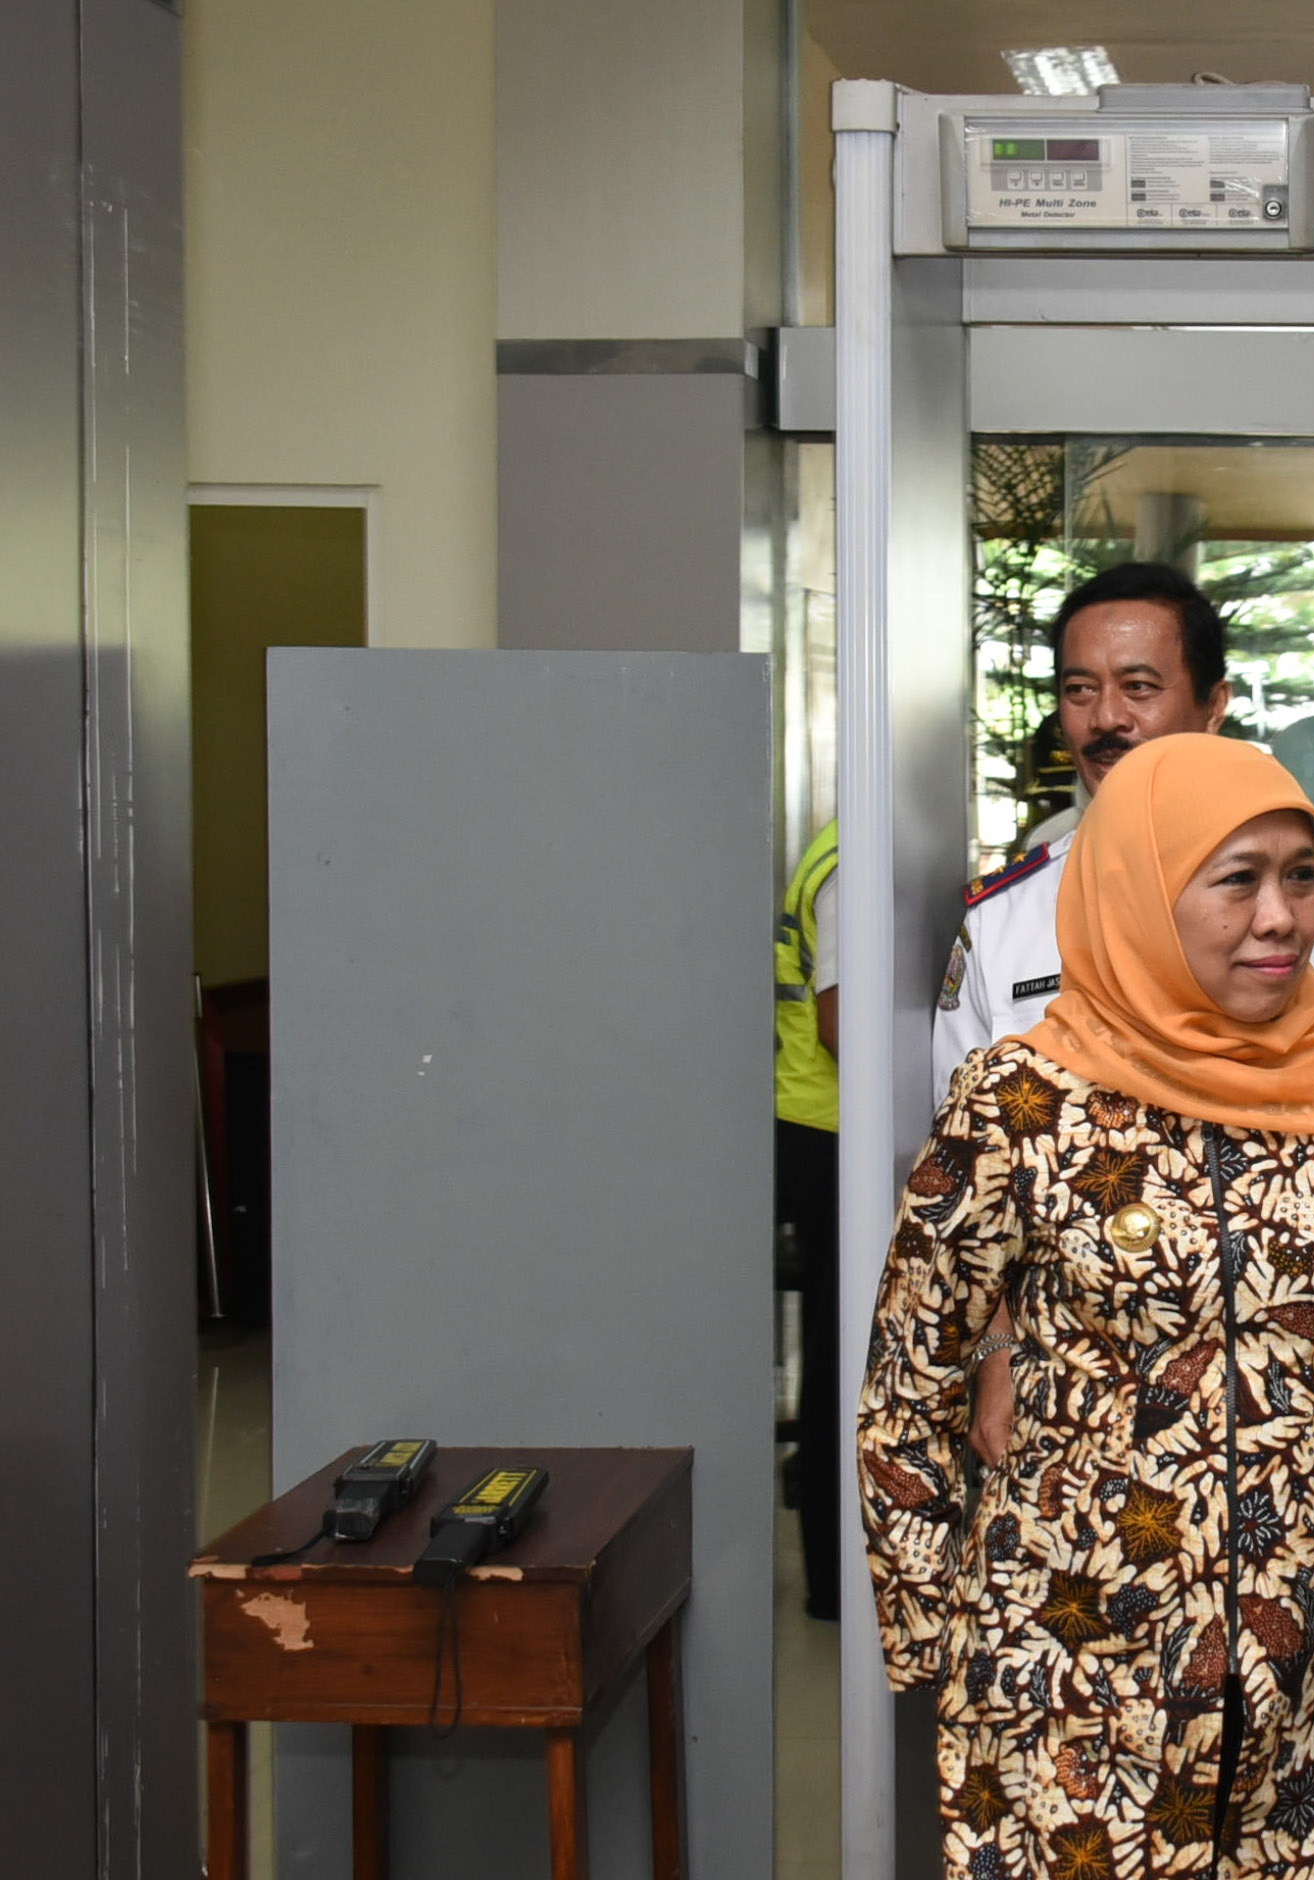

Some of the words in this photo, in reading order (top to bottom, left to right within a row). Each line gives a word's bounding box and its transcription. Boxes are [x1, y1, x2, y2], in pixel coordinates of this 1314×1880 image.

[1035, 198, 1064, 208] Multi
[1068, 199, 1097, 208] Zone
[1015, 979, 1046, 995] FATTAH
